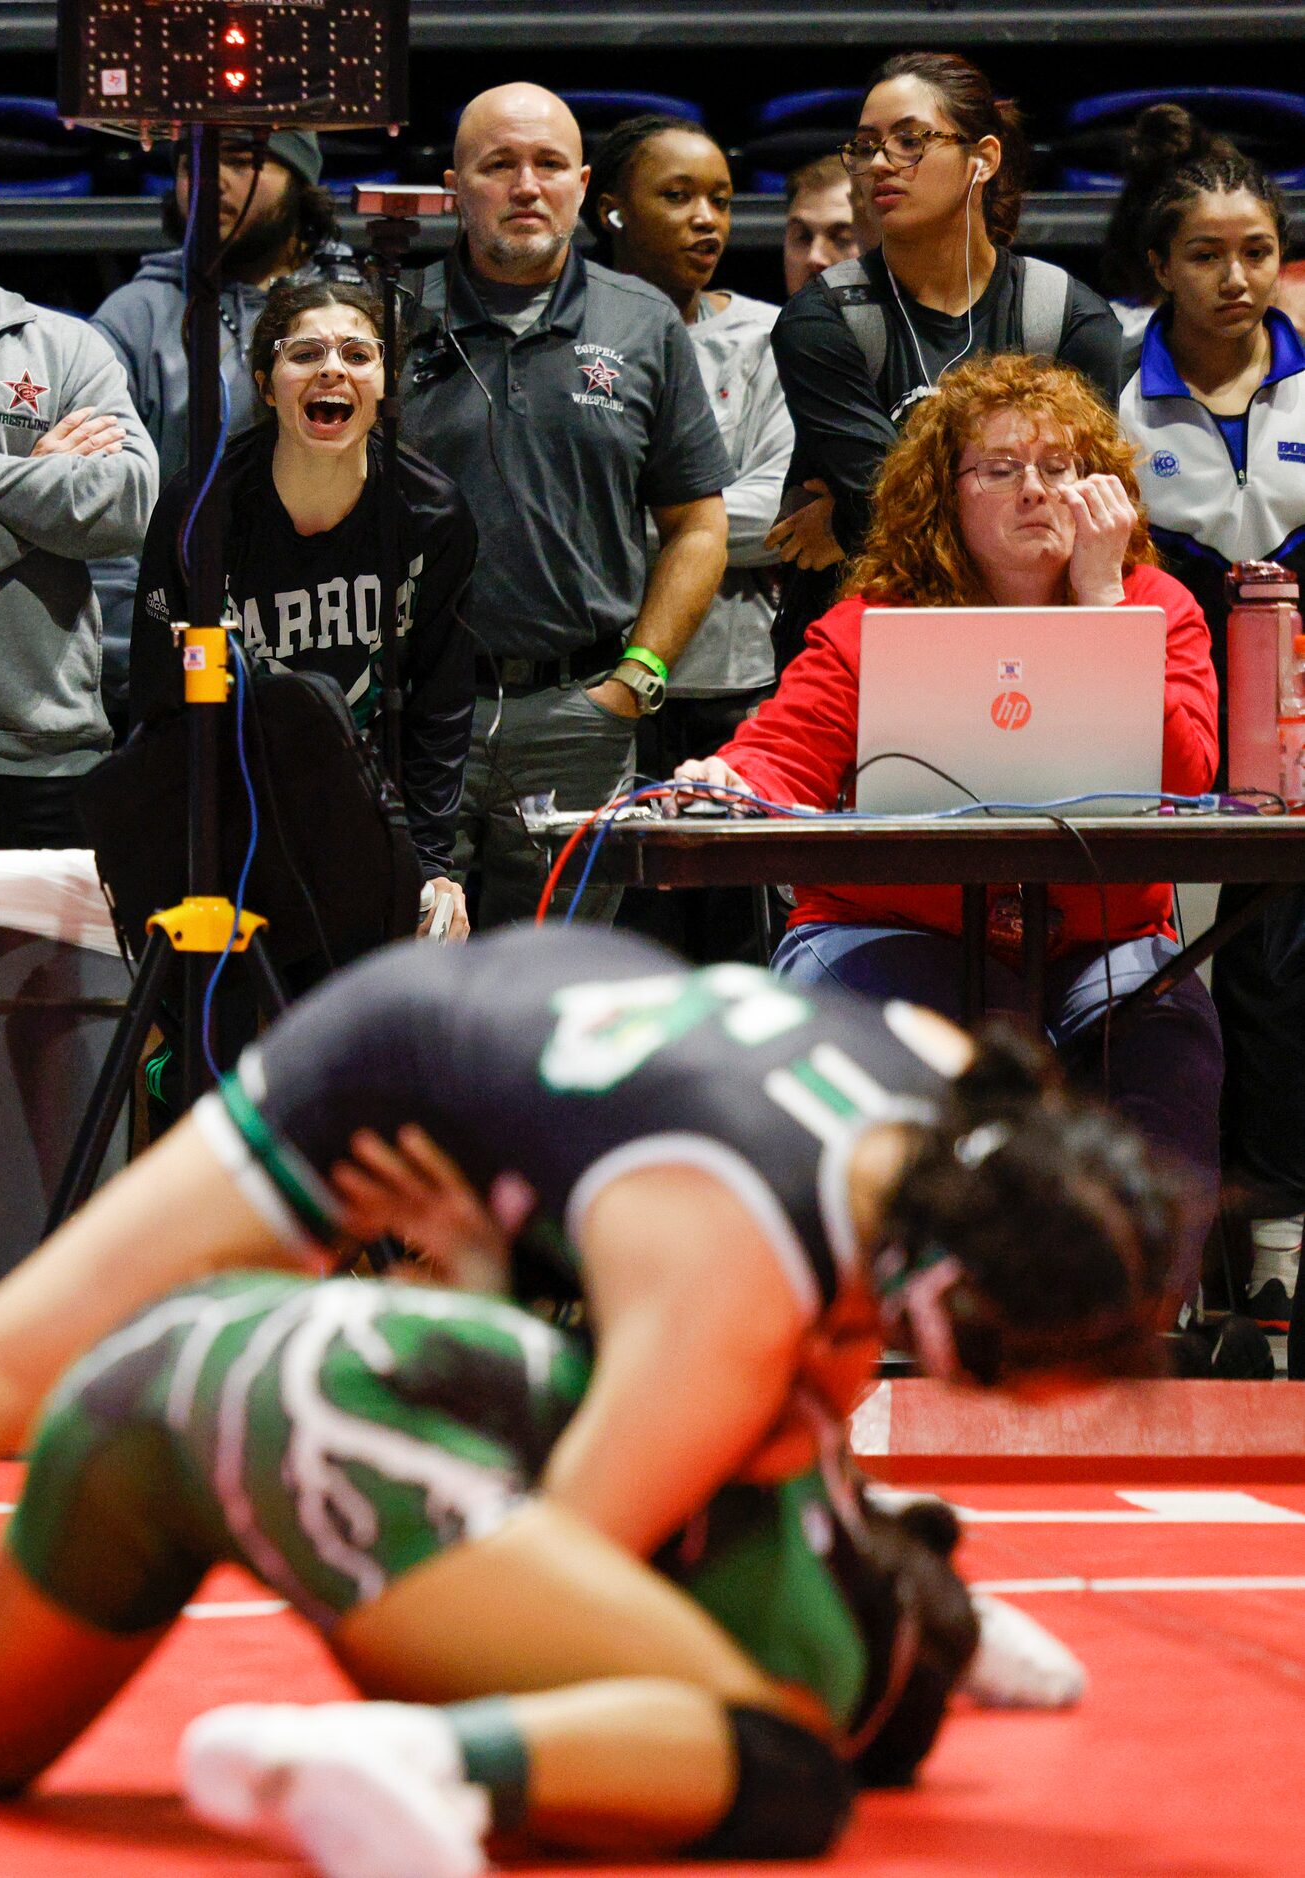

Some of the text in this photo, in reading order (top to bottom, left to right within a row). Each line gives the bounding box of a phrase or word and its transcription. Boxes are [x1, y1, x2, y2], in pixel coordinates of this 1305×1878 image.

[574, 344, 624, 365] COPPELL
[571, 392, 624, 412] WRESTLING
[997, 692, 1028, 733] hp
